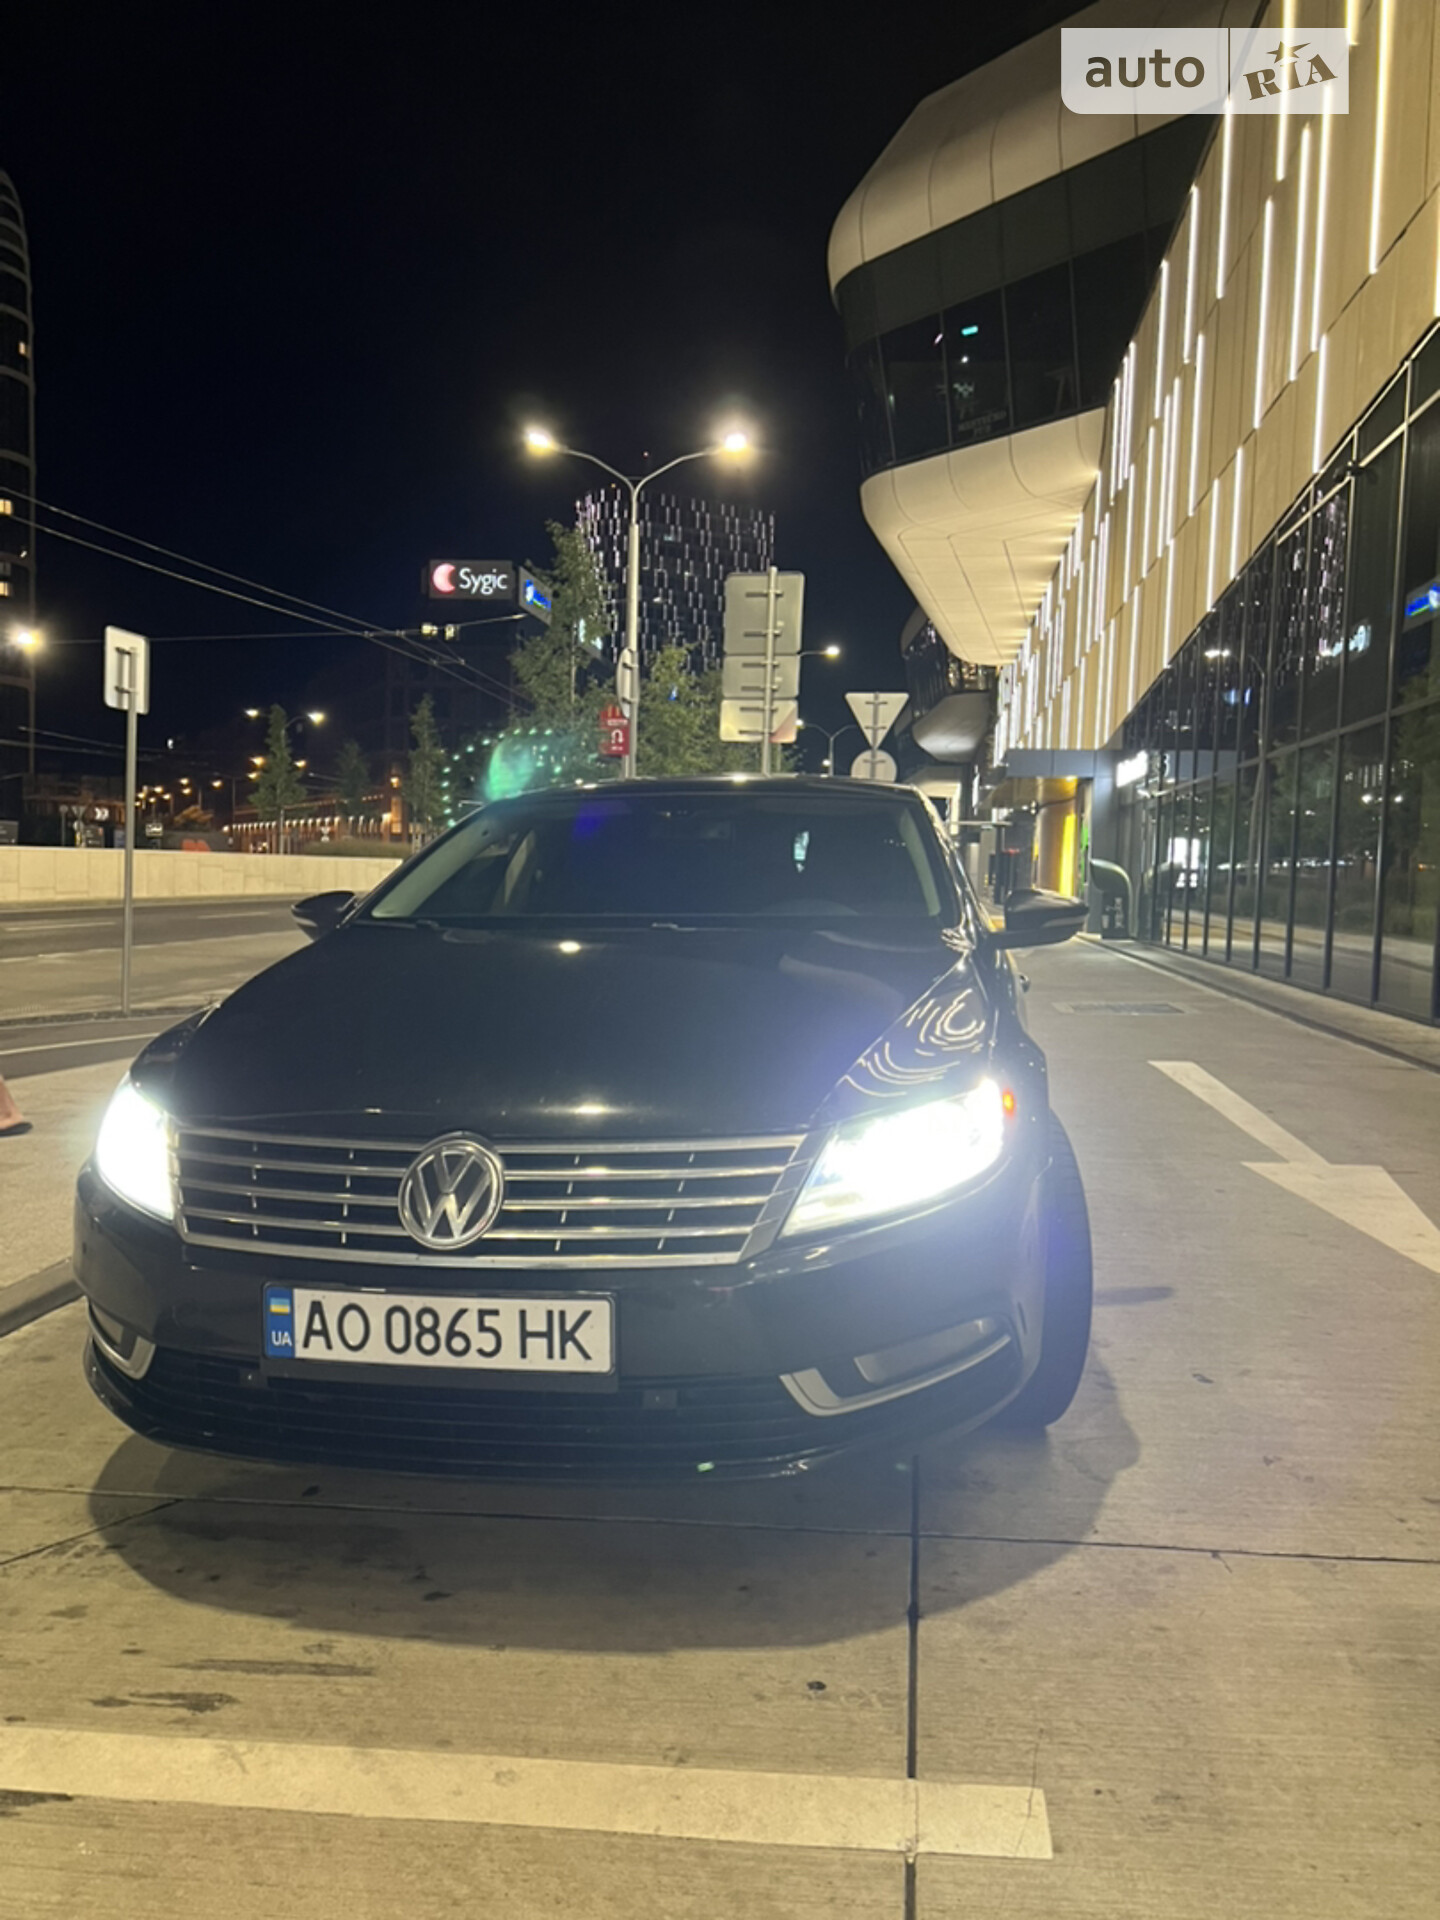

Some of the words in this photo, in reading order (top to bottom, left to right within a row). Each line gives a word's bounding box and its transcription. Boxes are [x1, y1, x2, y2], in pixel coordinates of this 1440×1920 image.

[459, 567, 508, 595] Sygic
[271, 1330, 293, 1347] UA
[302, 1300, 371, 1353] AO
[384, 1304, 502, 1358] 0865
[518, 1309, 593, 1361] HK
